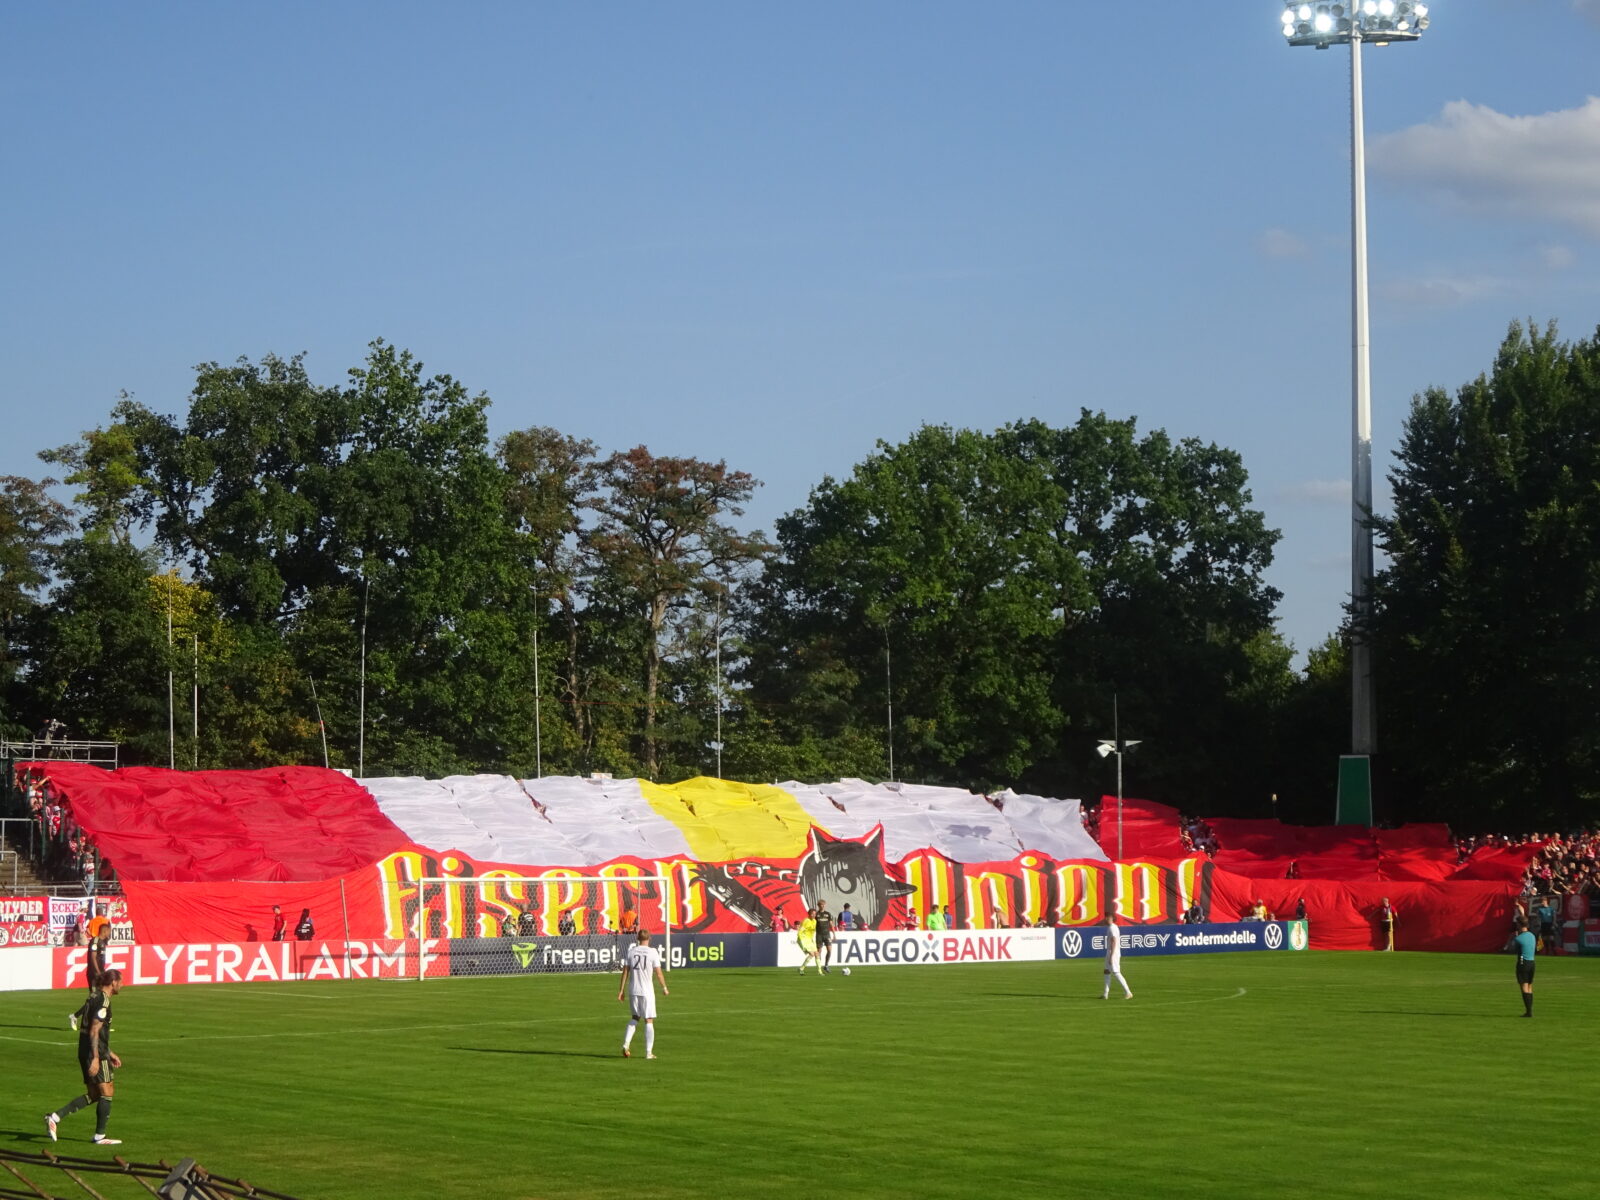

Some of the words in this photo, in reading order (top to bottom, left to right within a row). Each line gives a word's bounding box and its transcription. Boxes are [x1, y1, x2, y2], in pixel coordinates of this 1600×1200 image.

[51, 903, 79, 913] ECKE
[1175, 930, 1256, 946] Sondermodelle
[689, 941, 724, 961] los!
[105, 941, 406, 985] FLYERALARM
[633, 954, 648, 970] 21
